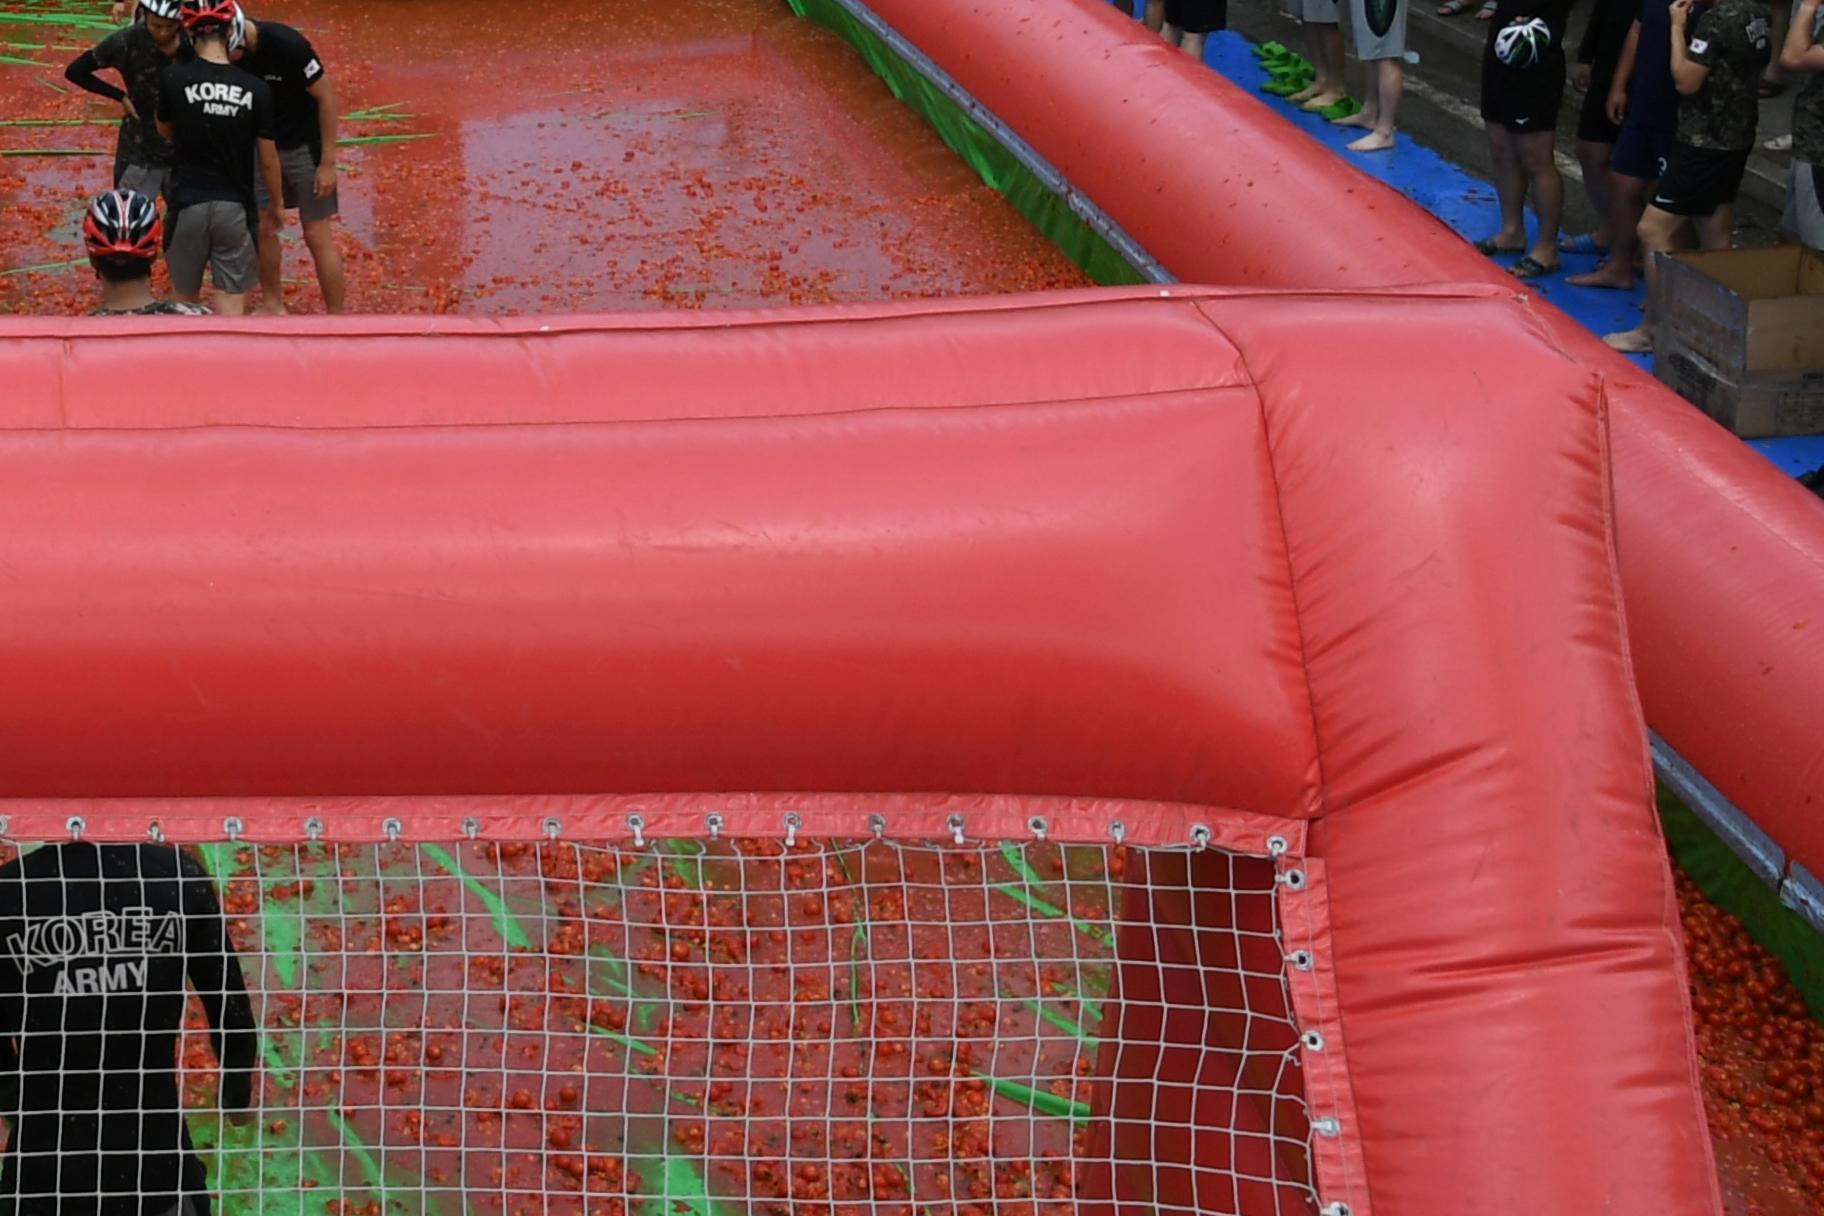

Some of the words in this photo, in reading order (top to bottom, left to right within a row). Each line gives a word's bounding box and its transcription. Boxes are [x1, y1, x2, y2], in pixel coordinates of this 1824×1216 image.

[184, 82, 253, 110] KOREA
[203, 102, 239, 117] ARMY
[5, 906, 181, 976] KOREA
[52, 959, 146, 996] ARMY
